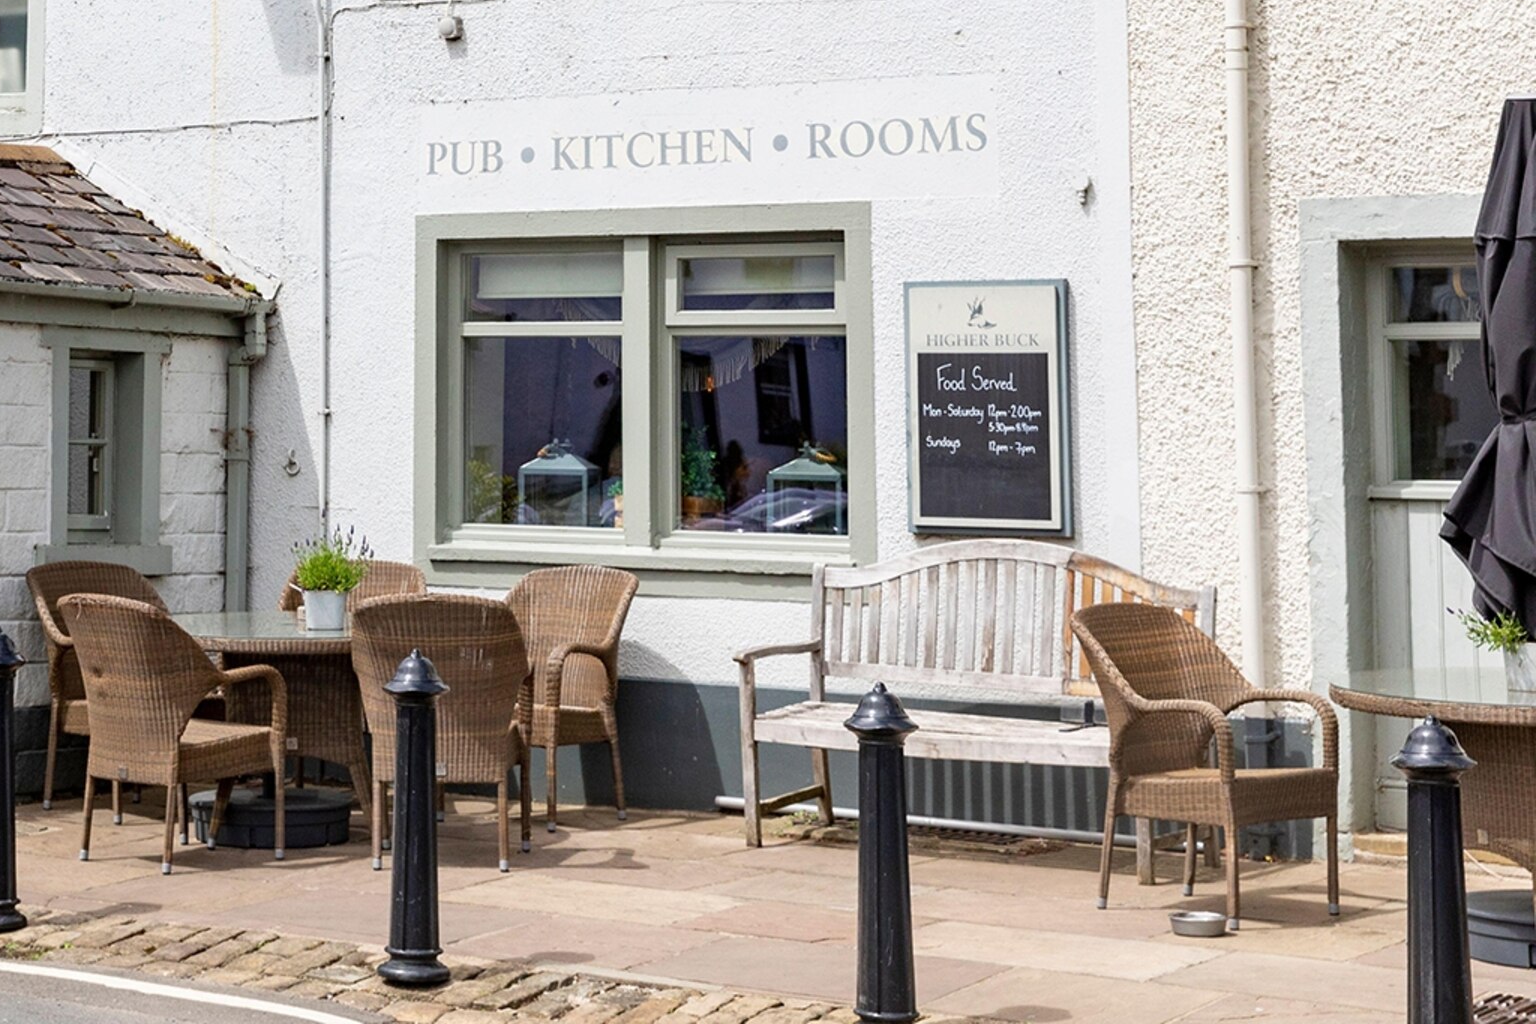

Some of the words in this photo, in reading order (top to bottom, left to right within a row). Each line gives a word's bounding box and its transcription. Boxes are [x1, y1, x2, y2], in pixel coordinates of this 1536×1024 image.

[426, 140, 504, 176] PUB
[551, 127, 754, 171] KITCHEN
[806, 113, 988, 159] ROOMS
[926, 333, 989, 347] HIGHER
[995, 333, 1040, 347] BUCK
[936, 363, 966, 392] Food
[971, 365, 1017, 392] Served
[926, 435, 961, 454] Sundays
